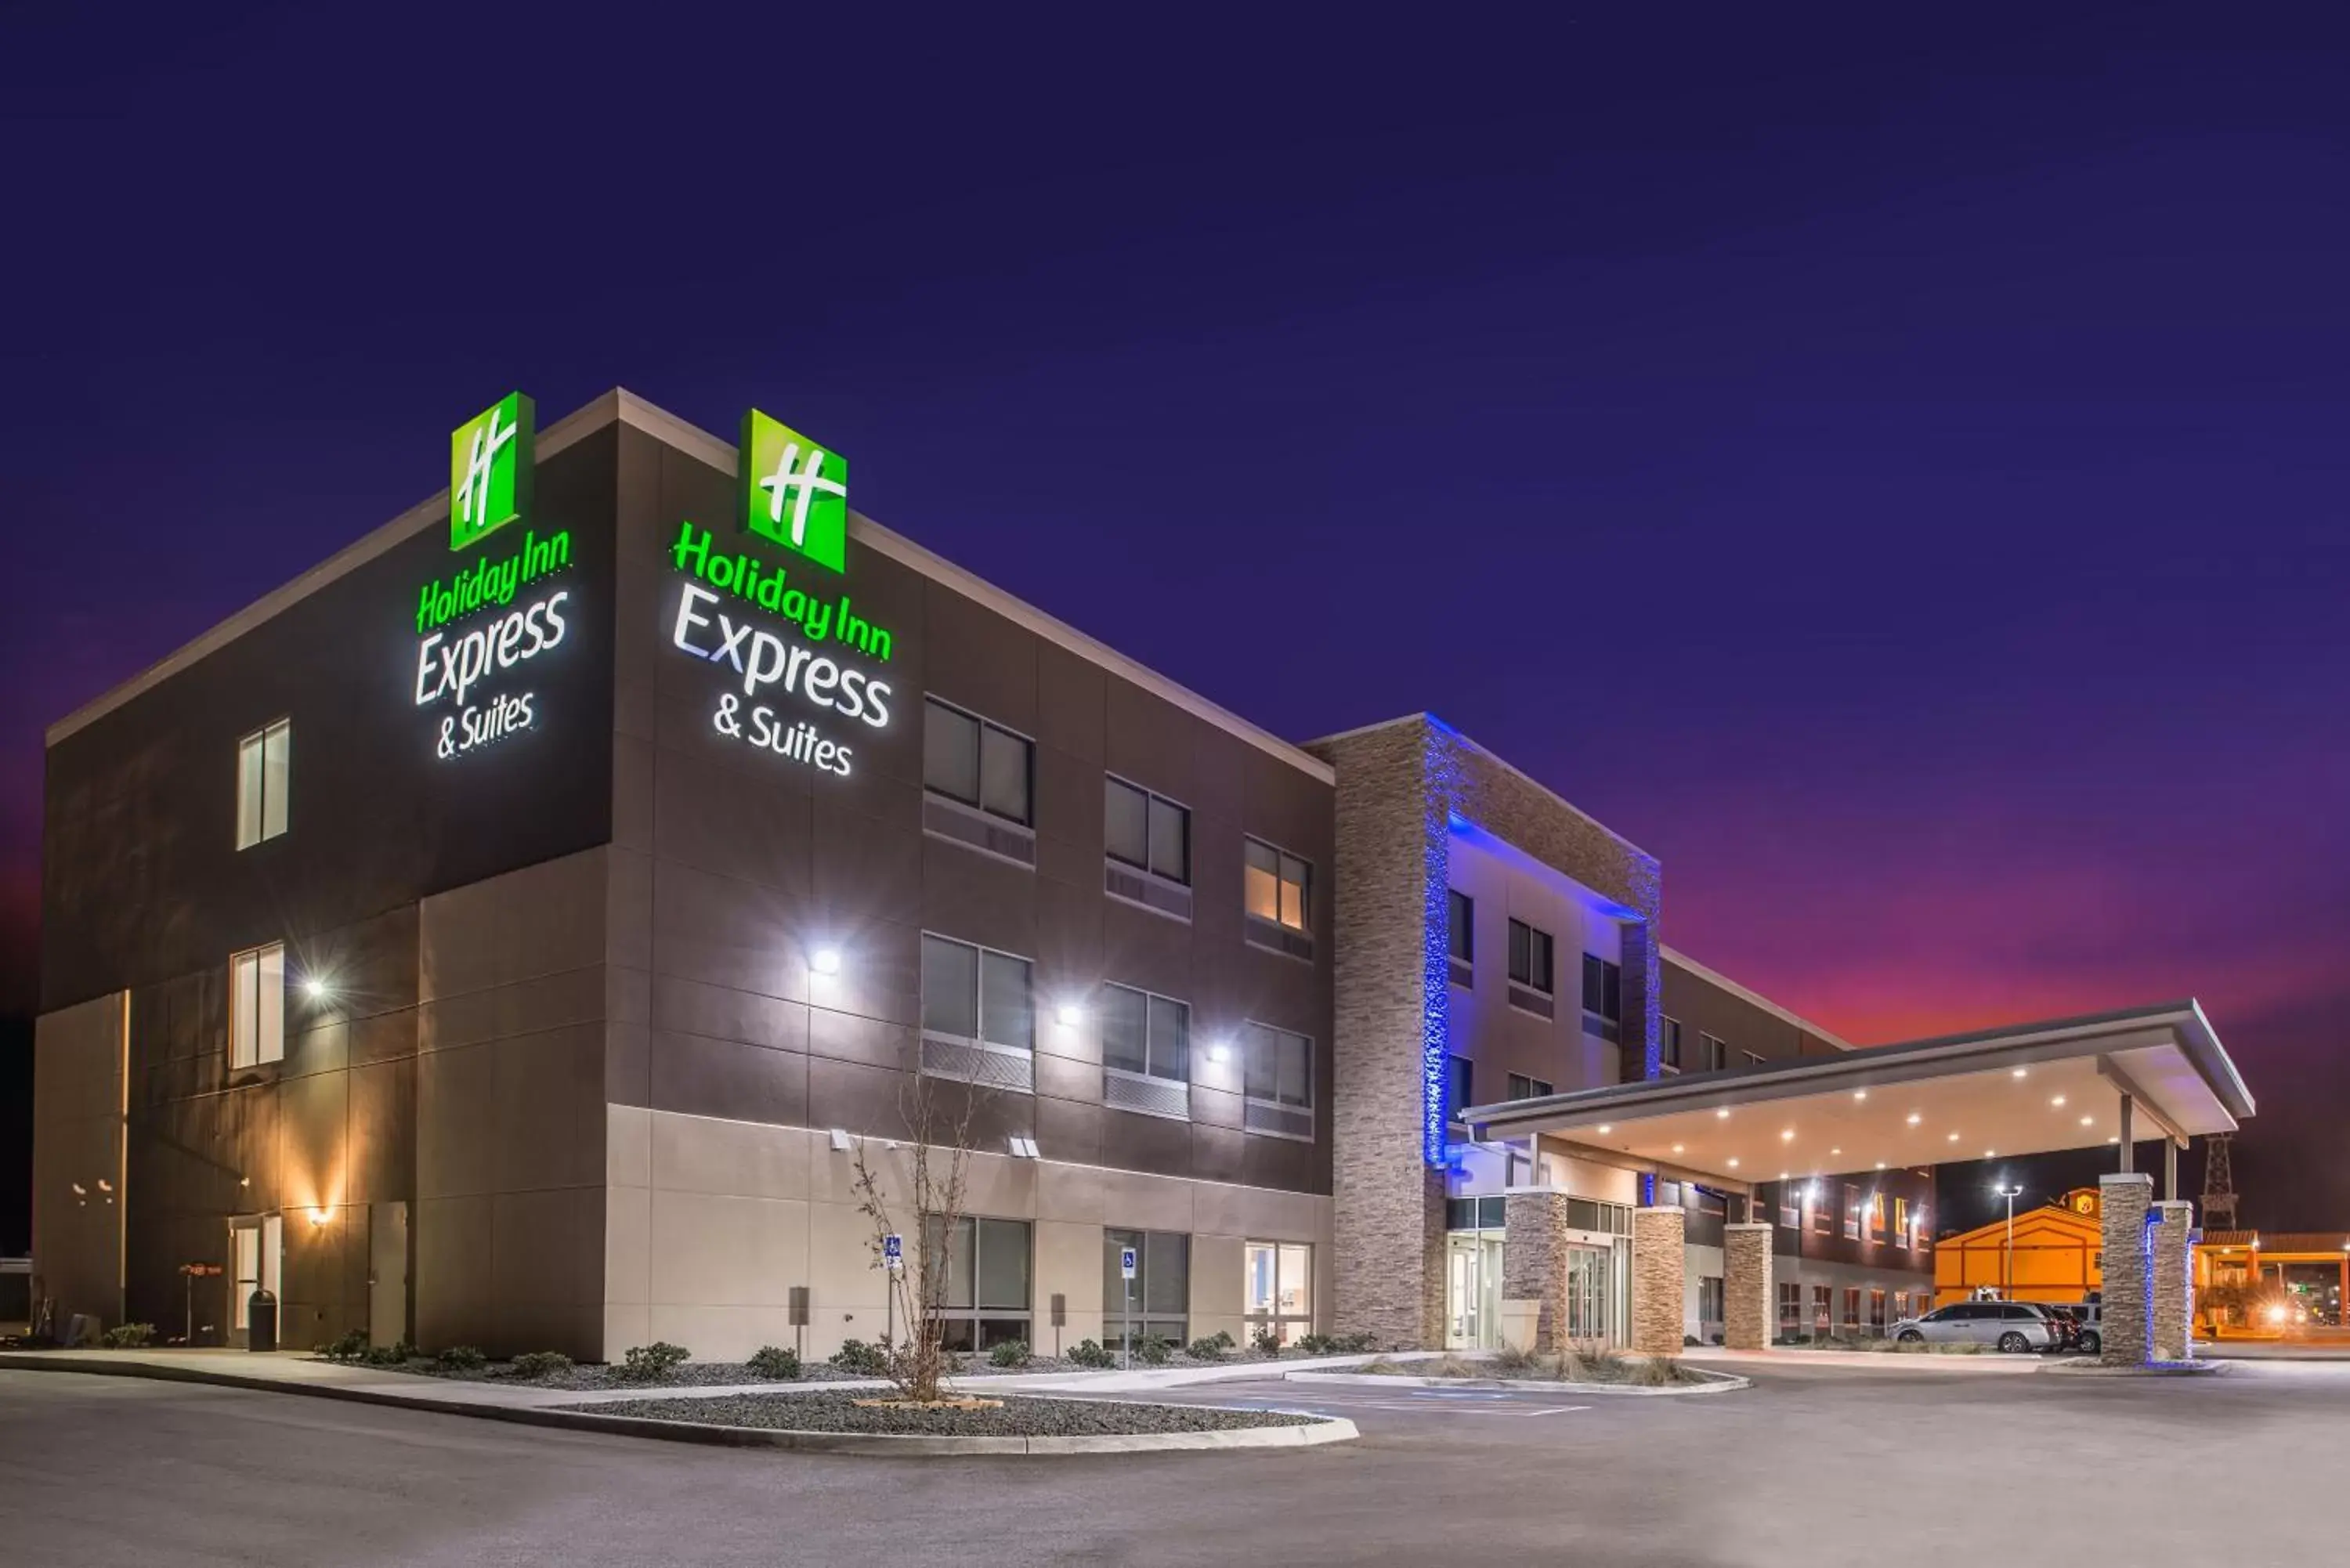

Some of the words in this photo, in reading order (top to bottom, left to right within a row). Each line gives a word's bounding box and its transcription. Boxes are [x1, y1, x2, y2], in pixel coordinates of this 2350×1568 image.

[416, 556, 519, 634] Holiday
[522, 529, 569, 583] Inn
[673, 521, 831, 641] Holiday
[836, 596, 891, 660] Inn
[415, 591, 569, 706] Express
[674, 582, 892, 728] Express
[437, 716, 455, 759] &
[459, 692, 533, 750] Suites
[714, 693, 741, 739] &
[748, 706, 852, 776] Suites
